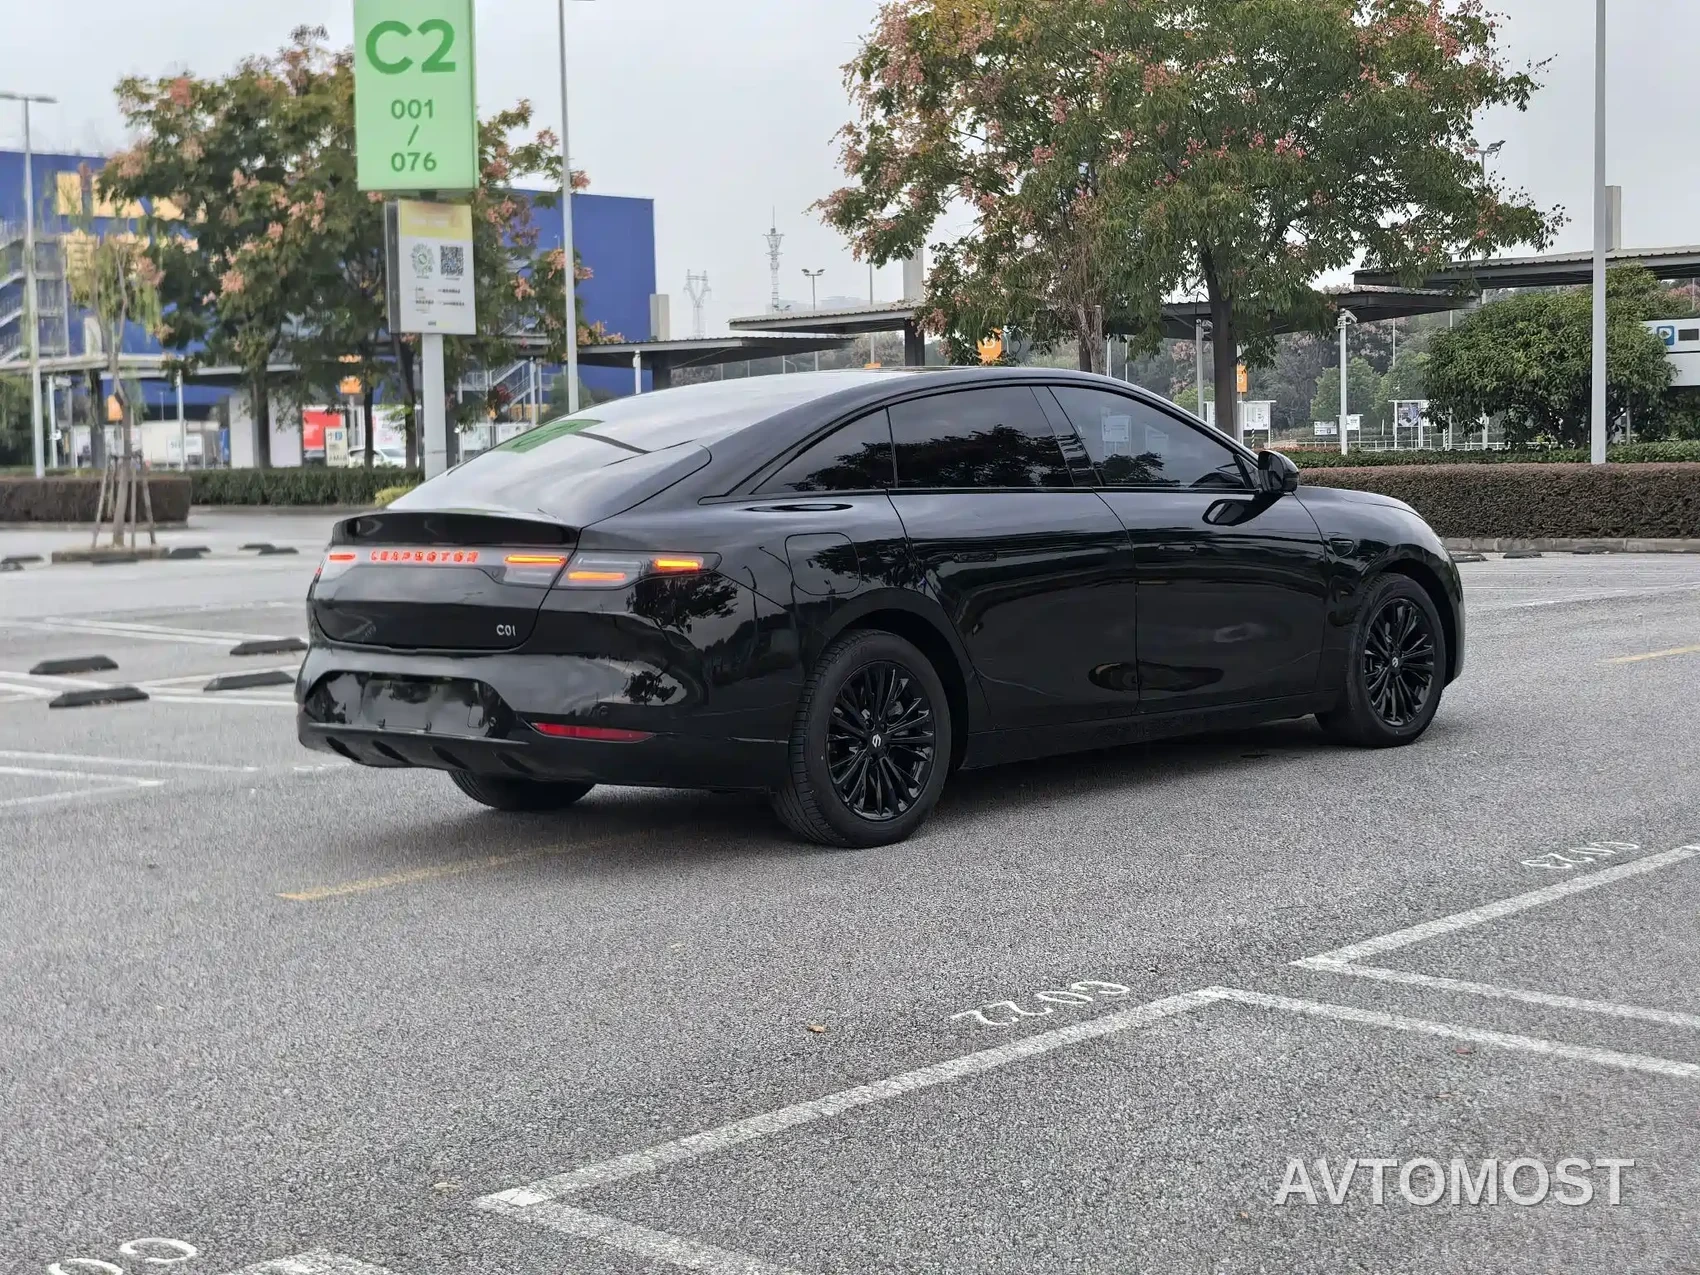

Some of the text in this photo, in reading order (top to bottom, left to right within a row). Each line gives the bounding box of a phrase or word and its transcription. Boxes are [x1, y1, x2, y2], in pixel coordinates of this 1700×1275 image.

[366, 19, 456, 74] C2
[391, 99, 433, 119] 001
[391, 152, 437, 172] 076
[950, 980, 1131, 1026] C022
